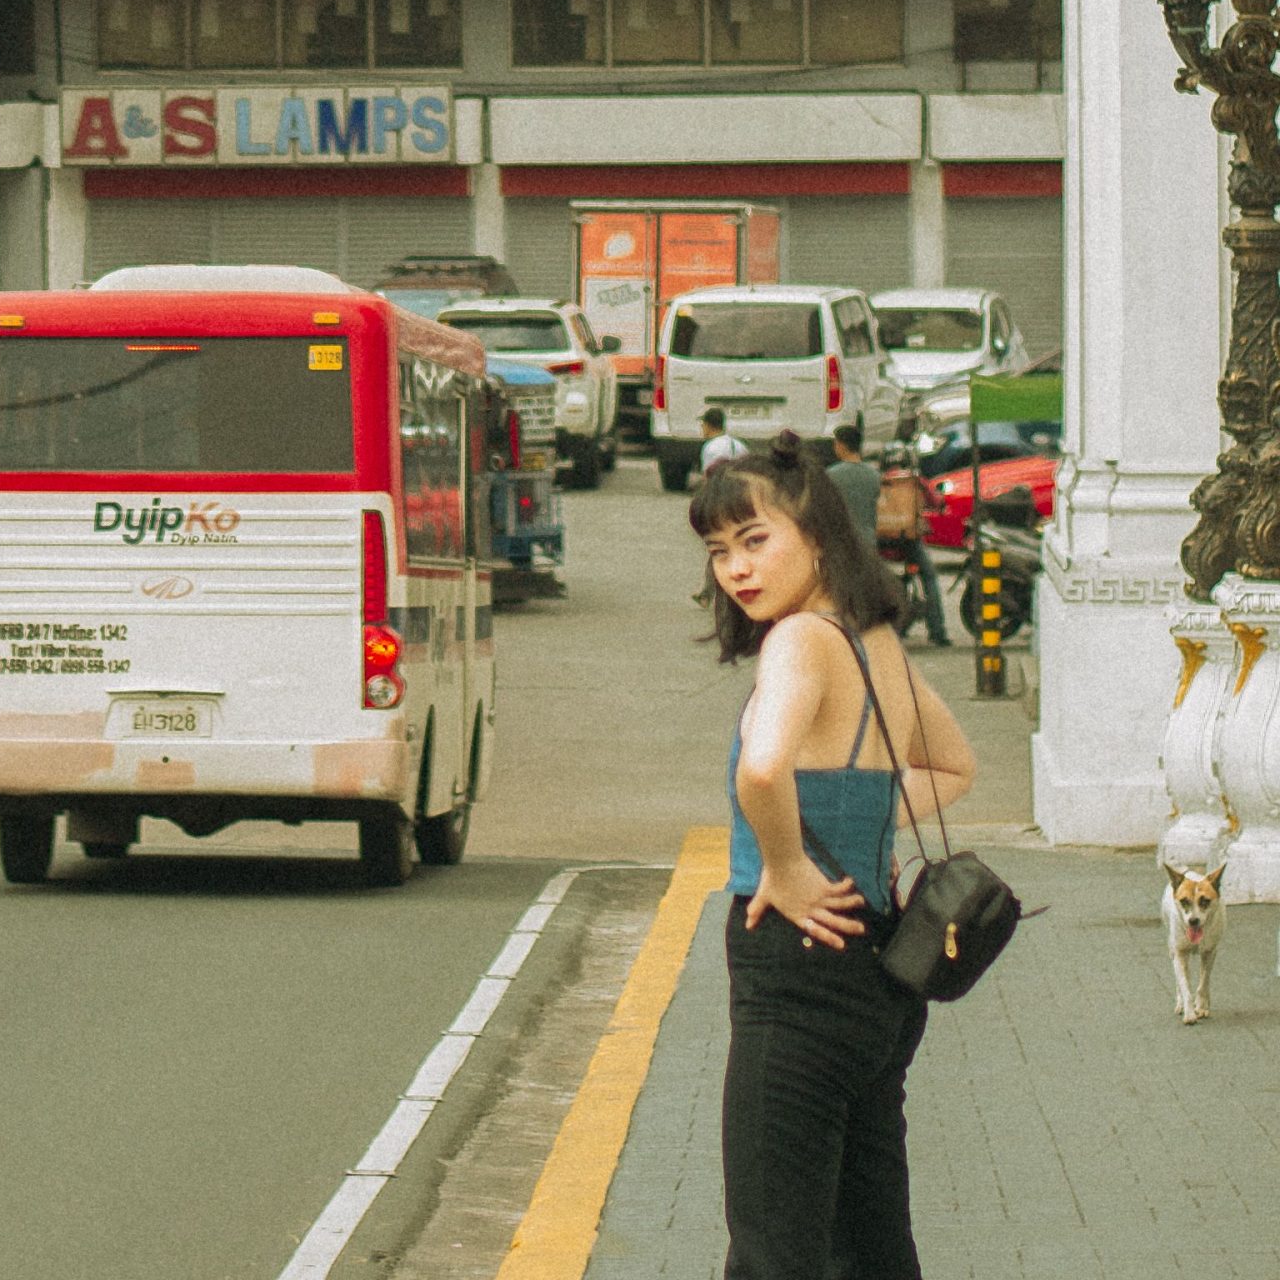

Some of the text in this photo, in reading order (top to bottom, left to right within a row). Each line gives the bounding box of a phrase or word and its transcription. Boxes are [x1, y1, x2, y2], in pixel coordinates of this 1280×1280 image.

[64, 96, 450, 158] A&S LAMPS
[94, 497, 241, 545] DyipKo
[170, 533, 200, 546] Dyip
[100, 623, 128, 641] 1342
